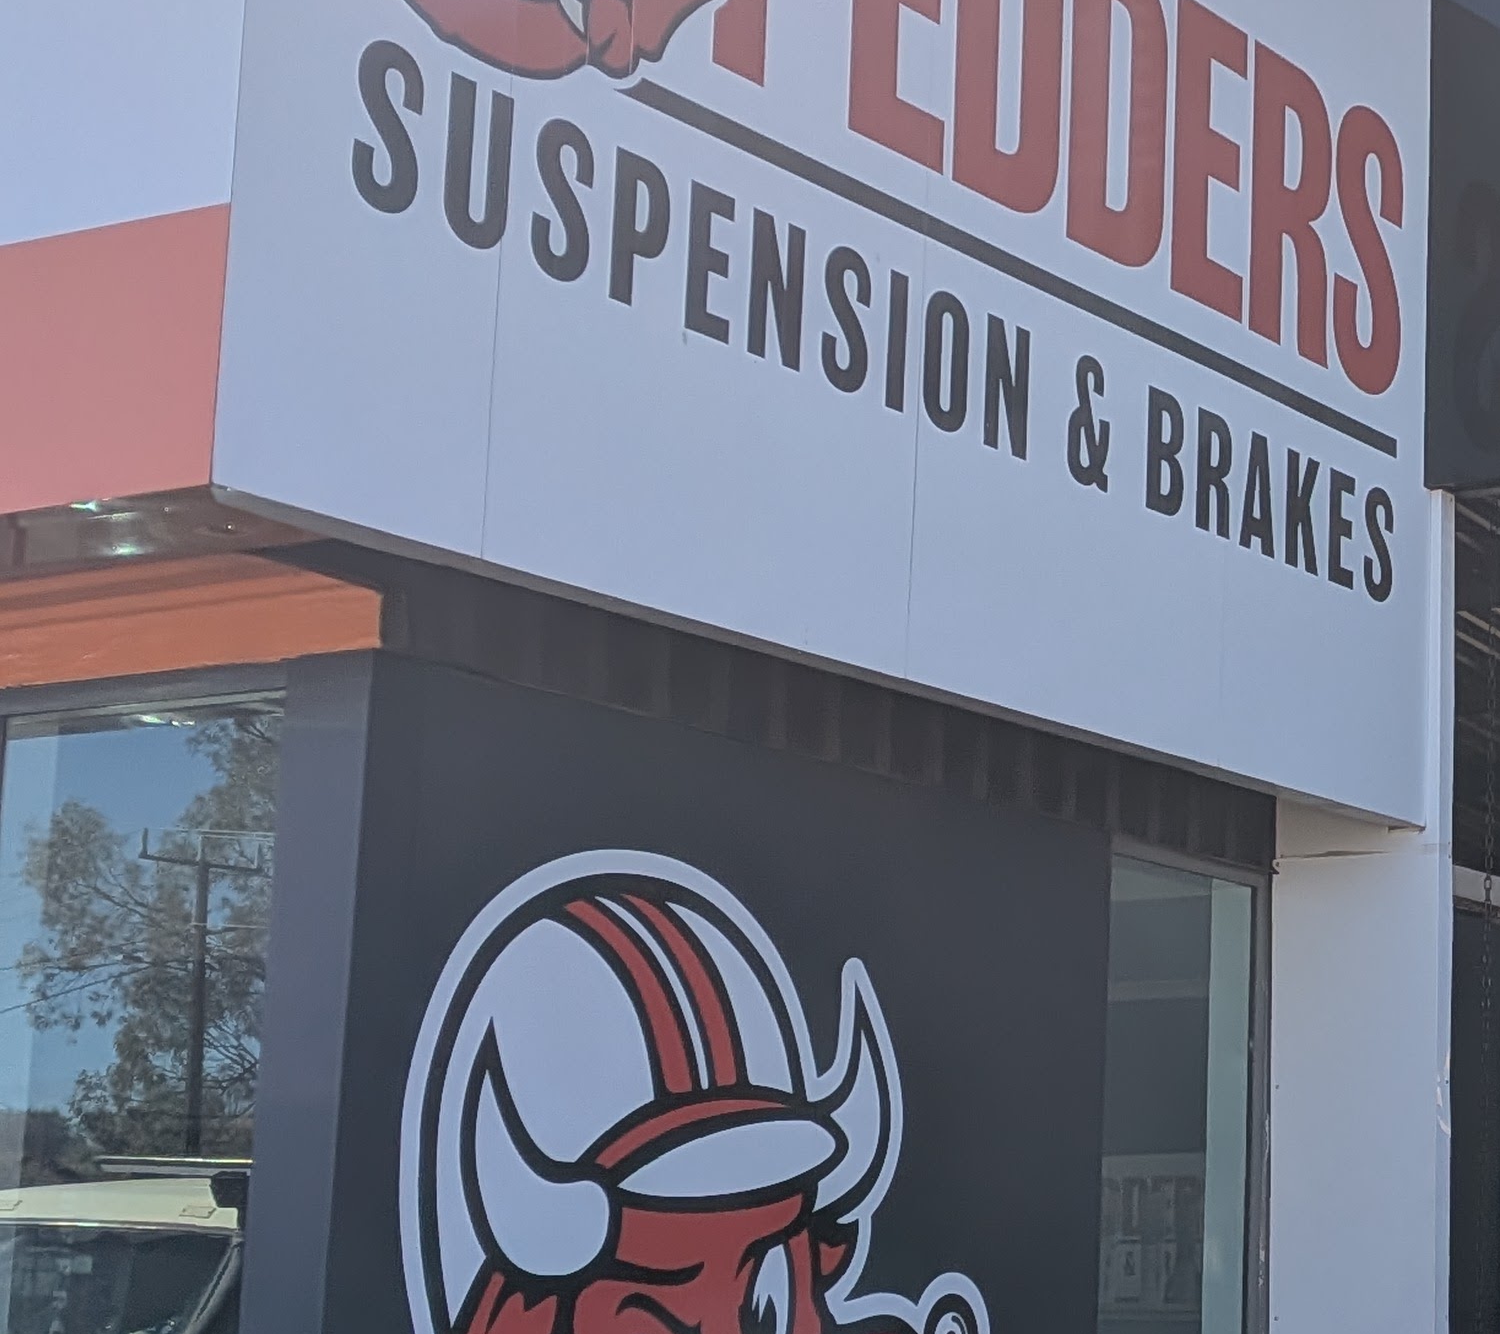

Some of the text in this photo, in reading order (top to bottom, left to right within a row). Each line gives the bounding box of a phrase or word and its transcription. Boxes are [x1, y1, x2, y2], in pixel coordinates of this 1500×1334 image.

[352, 40, 1396, 602] SUSPENSION & BRAKES
